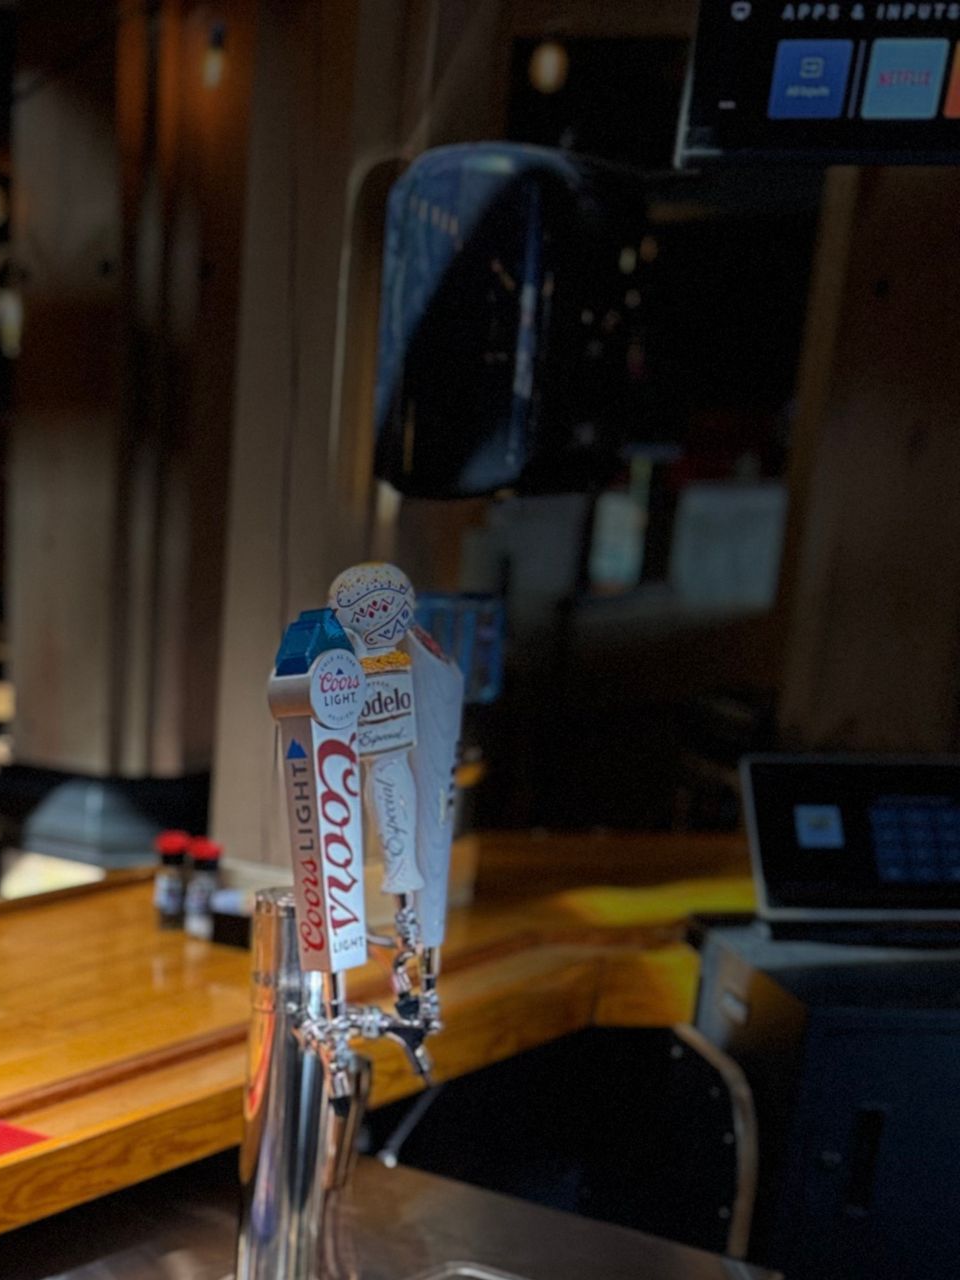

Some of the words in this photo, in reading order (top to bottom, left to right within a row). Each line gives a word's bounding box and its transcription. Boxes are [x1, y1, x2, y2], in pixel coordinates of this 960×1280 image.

[782, 3, 840, 21] APPS
[320, 671, 360, 694] Coors
[324, 692, 356, 707] LIGHT
[360, 690, 411, 718] odelo
[292, 760, 316, 851] LIGHT
[317, 732, 360, 936] Coors
[299, 857, 326, 952] Coors
[333, 937, 364, 954] LIGHT
